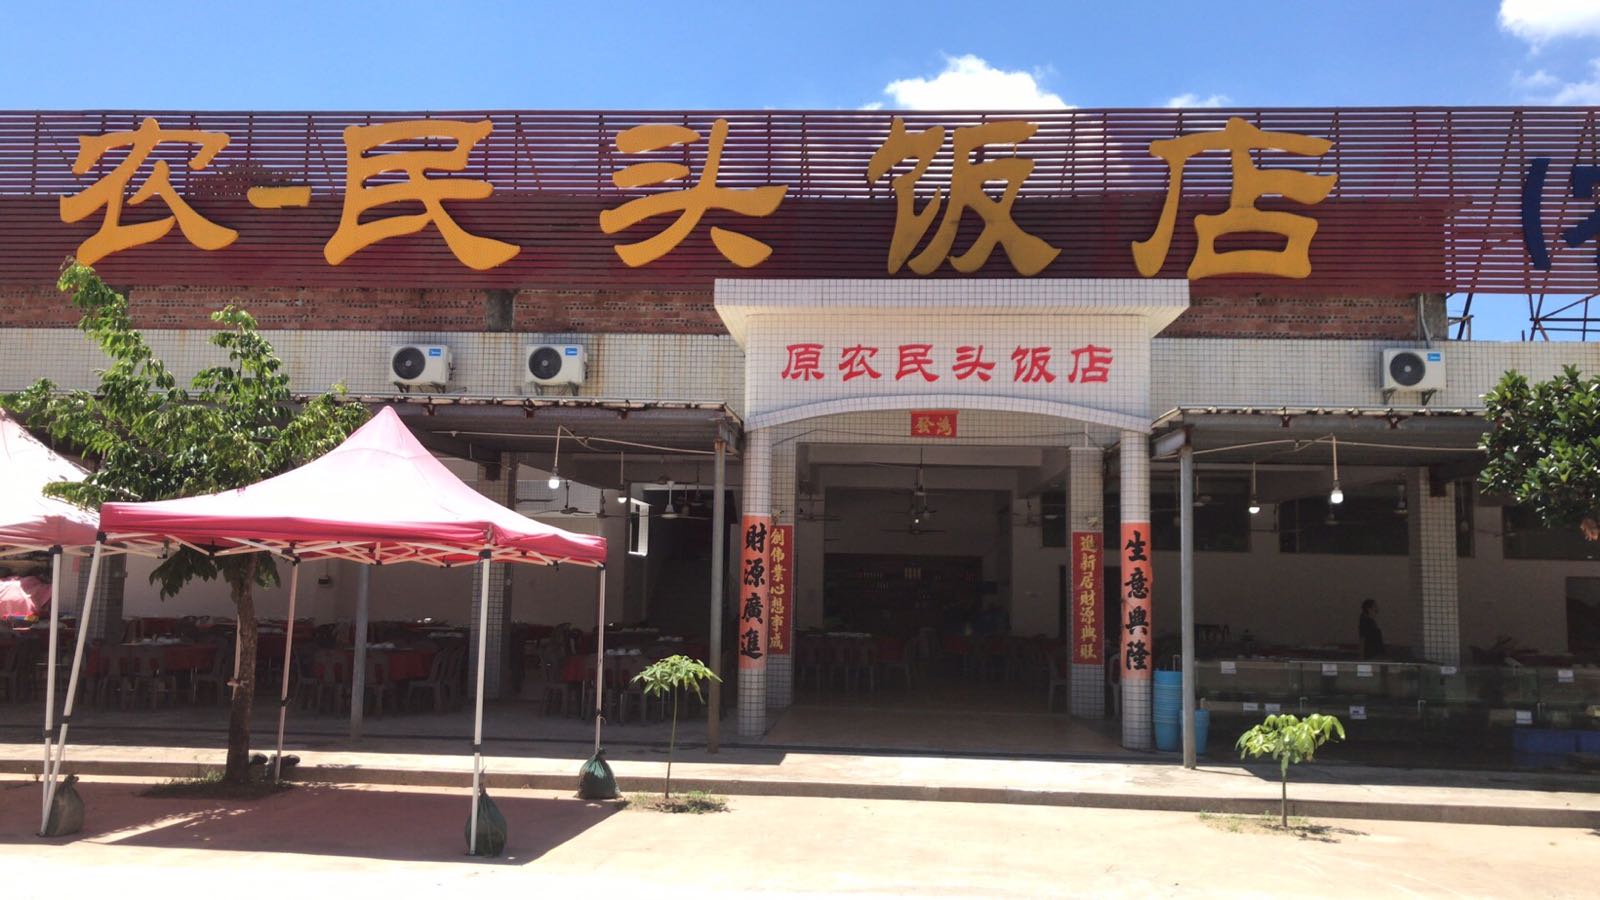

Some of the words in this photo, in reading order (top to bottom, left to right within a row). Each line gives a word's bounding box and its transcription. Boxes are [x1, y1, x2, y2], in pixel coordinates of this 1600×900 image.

[781, 342, 1114, 384] 原农民头饭店
